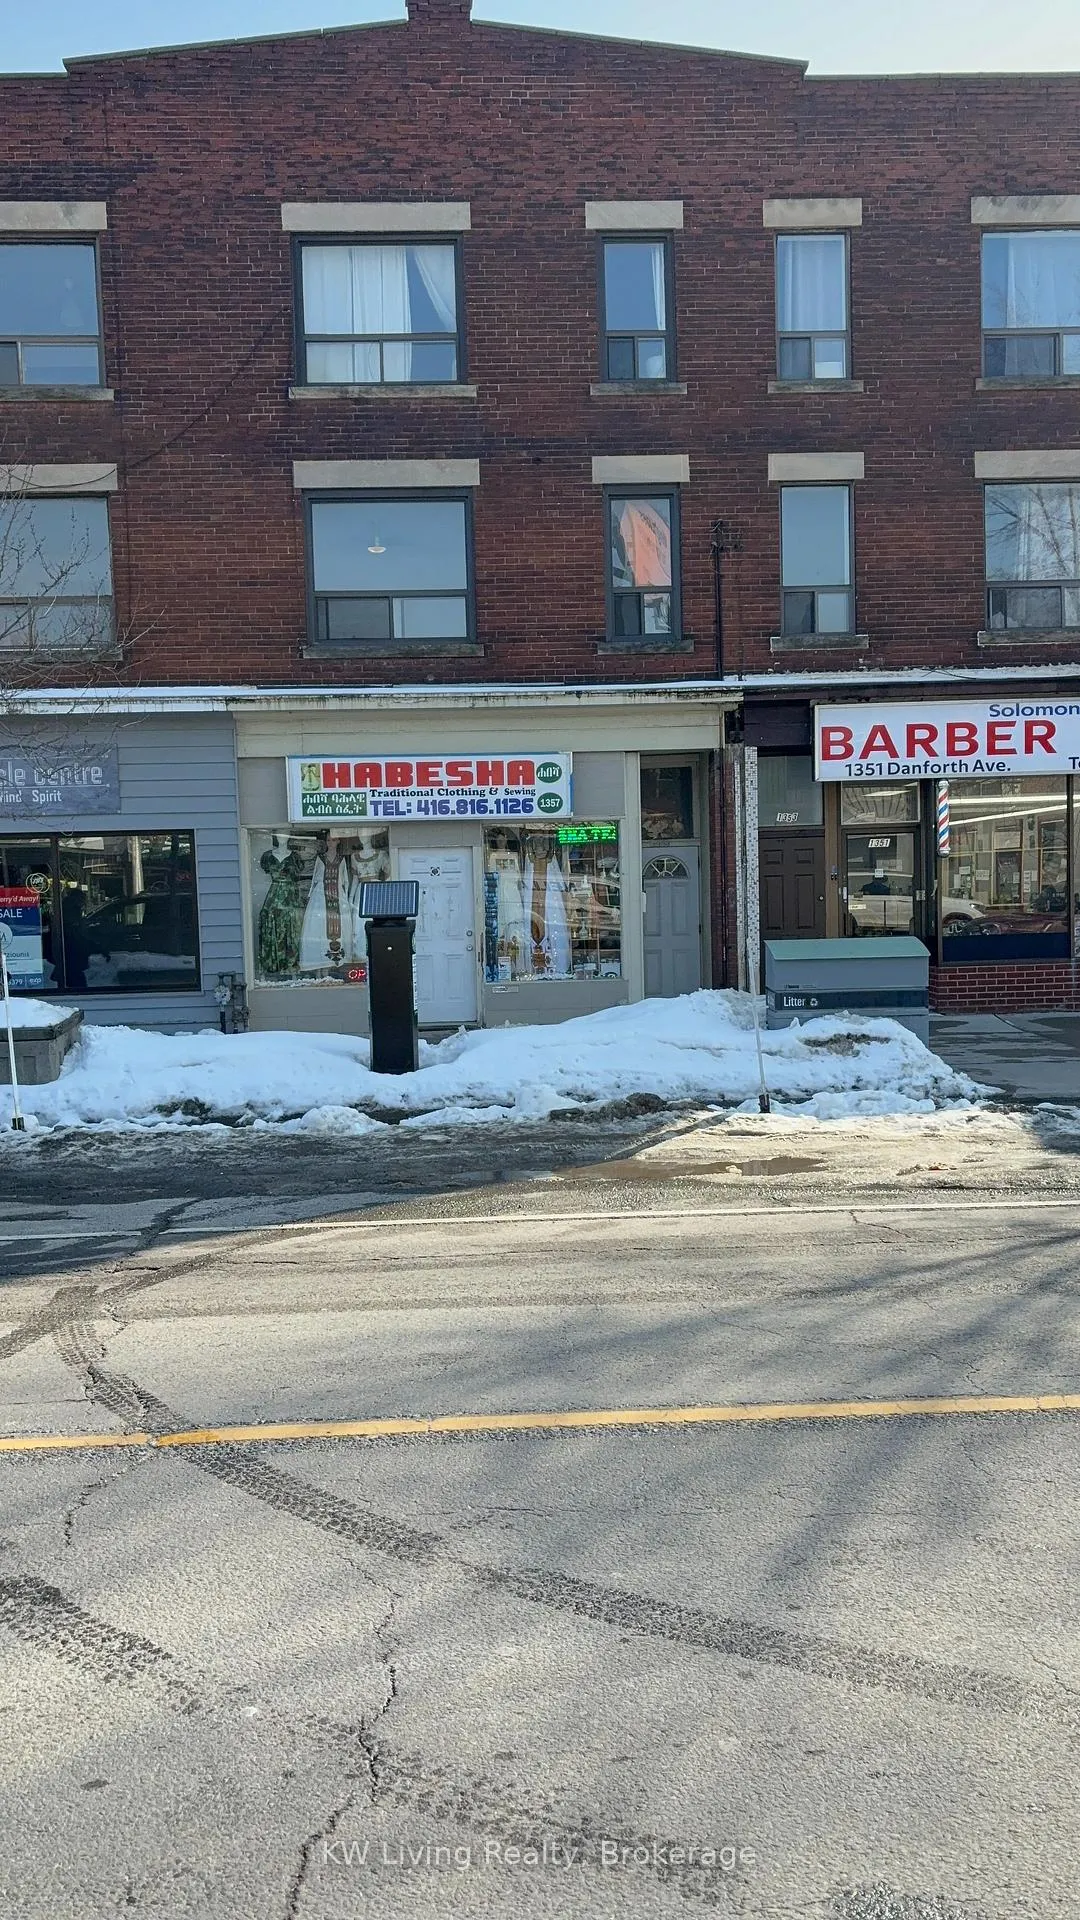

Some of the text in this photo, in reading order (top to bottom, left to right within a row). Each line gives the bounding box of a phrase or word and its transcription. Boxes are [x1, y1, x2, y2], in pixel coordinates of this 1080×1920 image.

[989, 703, 1080, 717] Solomon
[821, 719, 1057, 761] BARBER
[322, 760, 536, 788] HABESHA
[845, 758, 1011, 777] 1351 Danforth Ave.
[32, 789, 62, 804] Spirit
[369, 787, 536, 798] Traditional Clothing & Sewing
[370, 798, 534, 816] TEL: 416.816.1126
[540, 798, 561, 808] 1357
[783, 996, 806, 1007] Litter
